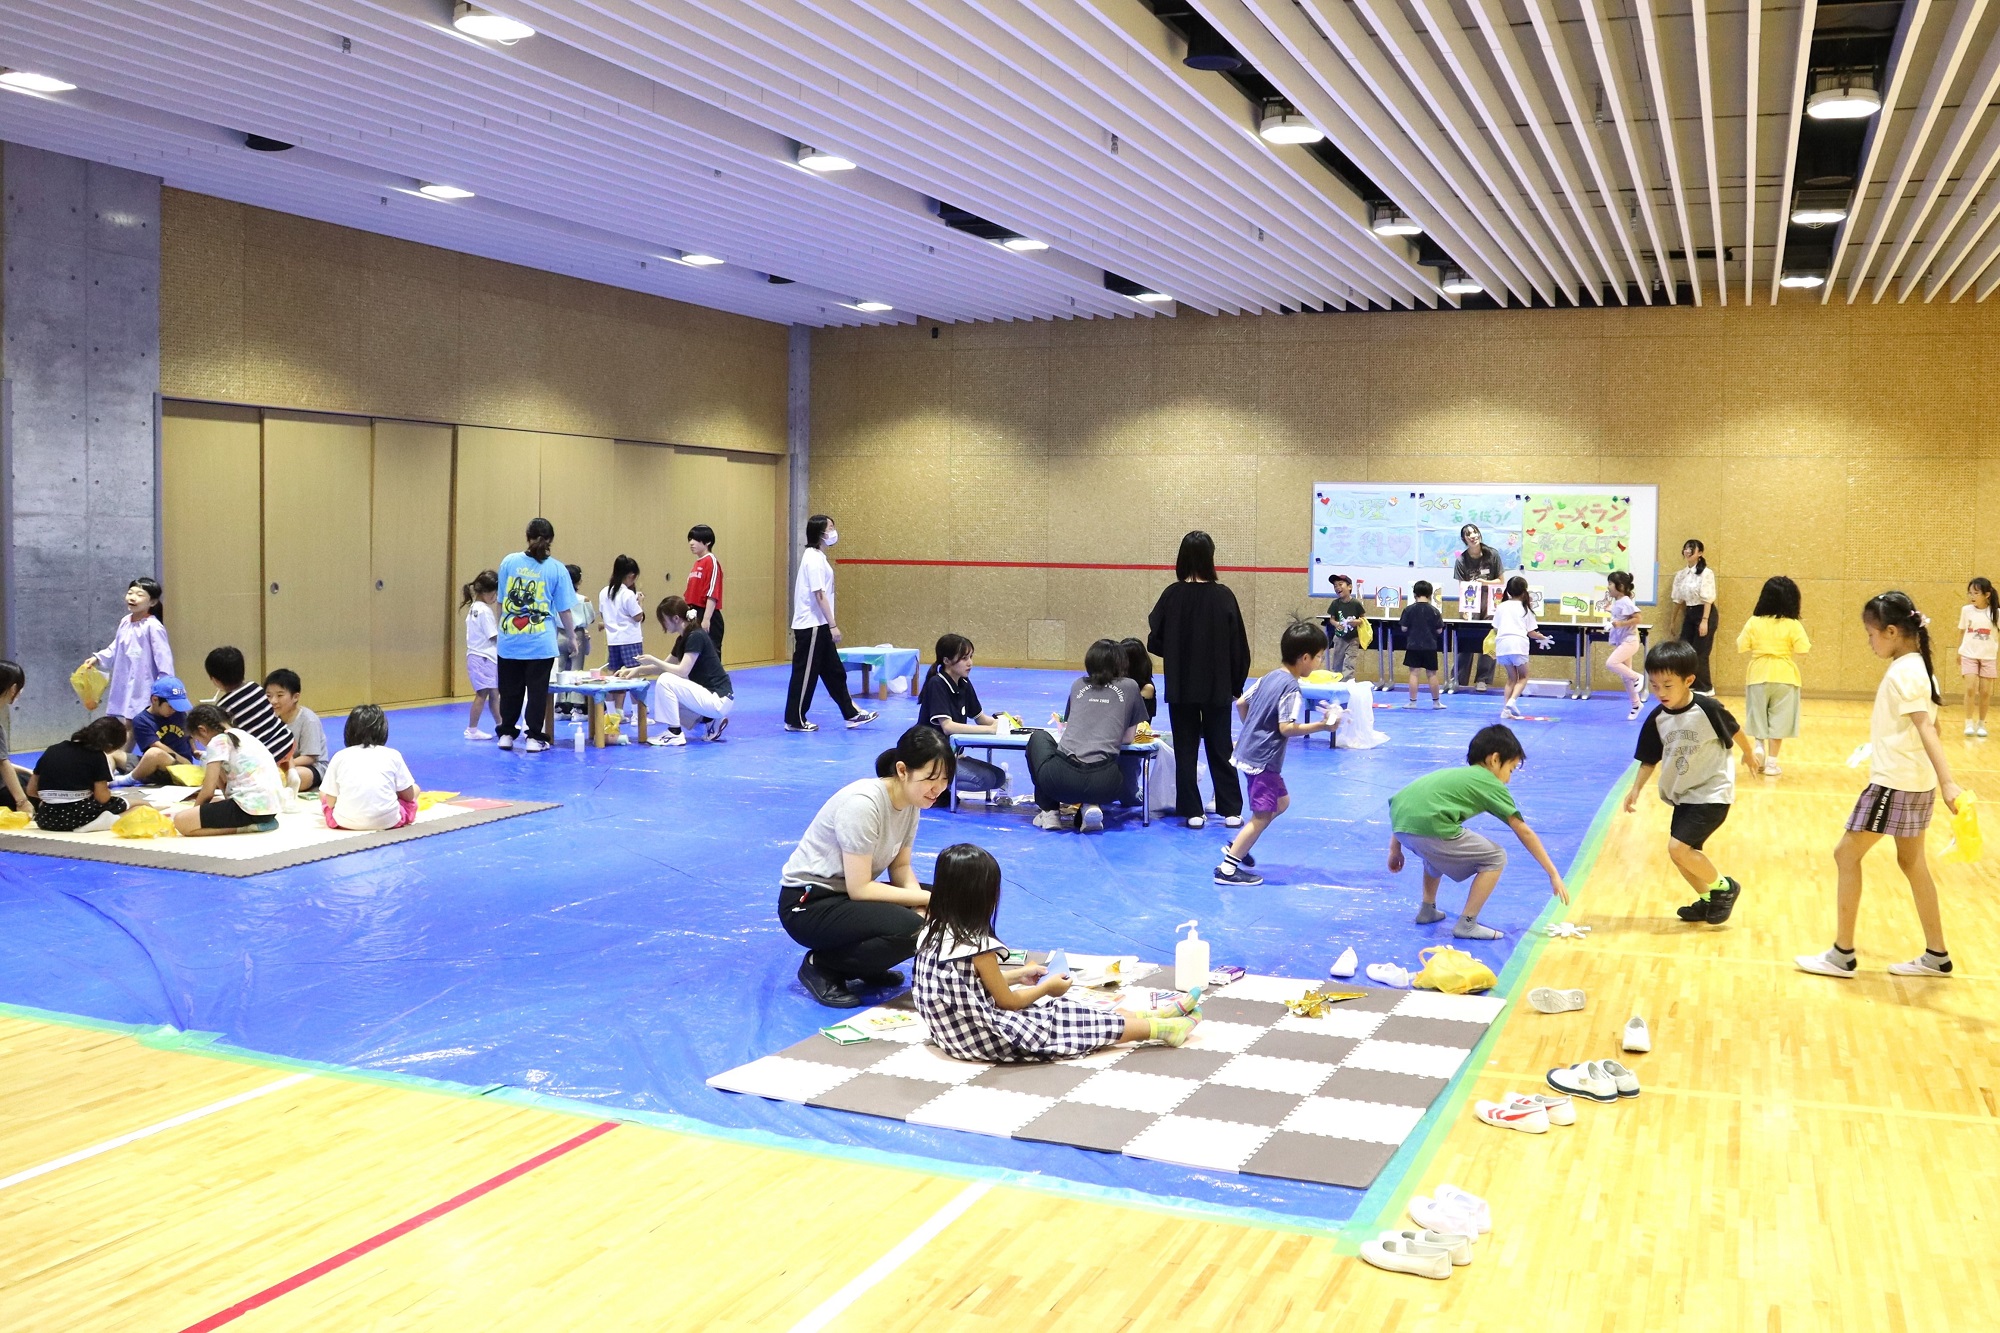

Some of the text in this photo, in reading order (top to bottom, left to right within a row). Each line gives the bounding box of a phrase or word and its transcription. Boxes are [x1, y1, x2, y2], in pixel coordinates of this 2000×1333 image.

[1532, 502, 1627, 523] ブーメラン
